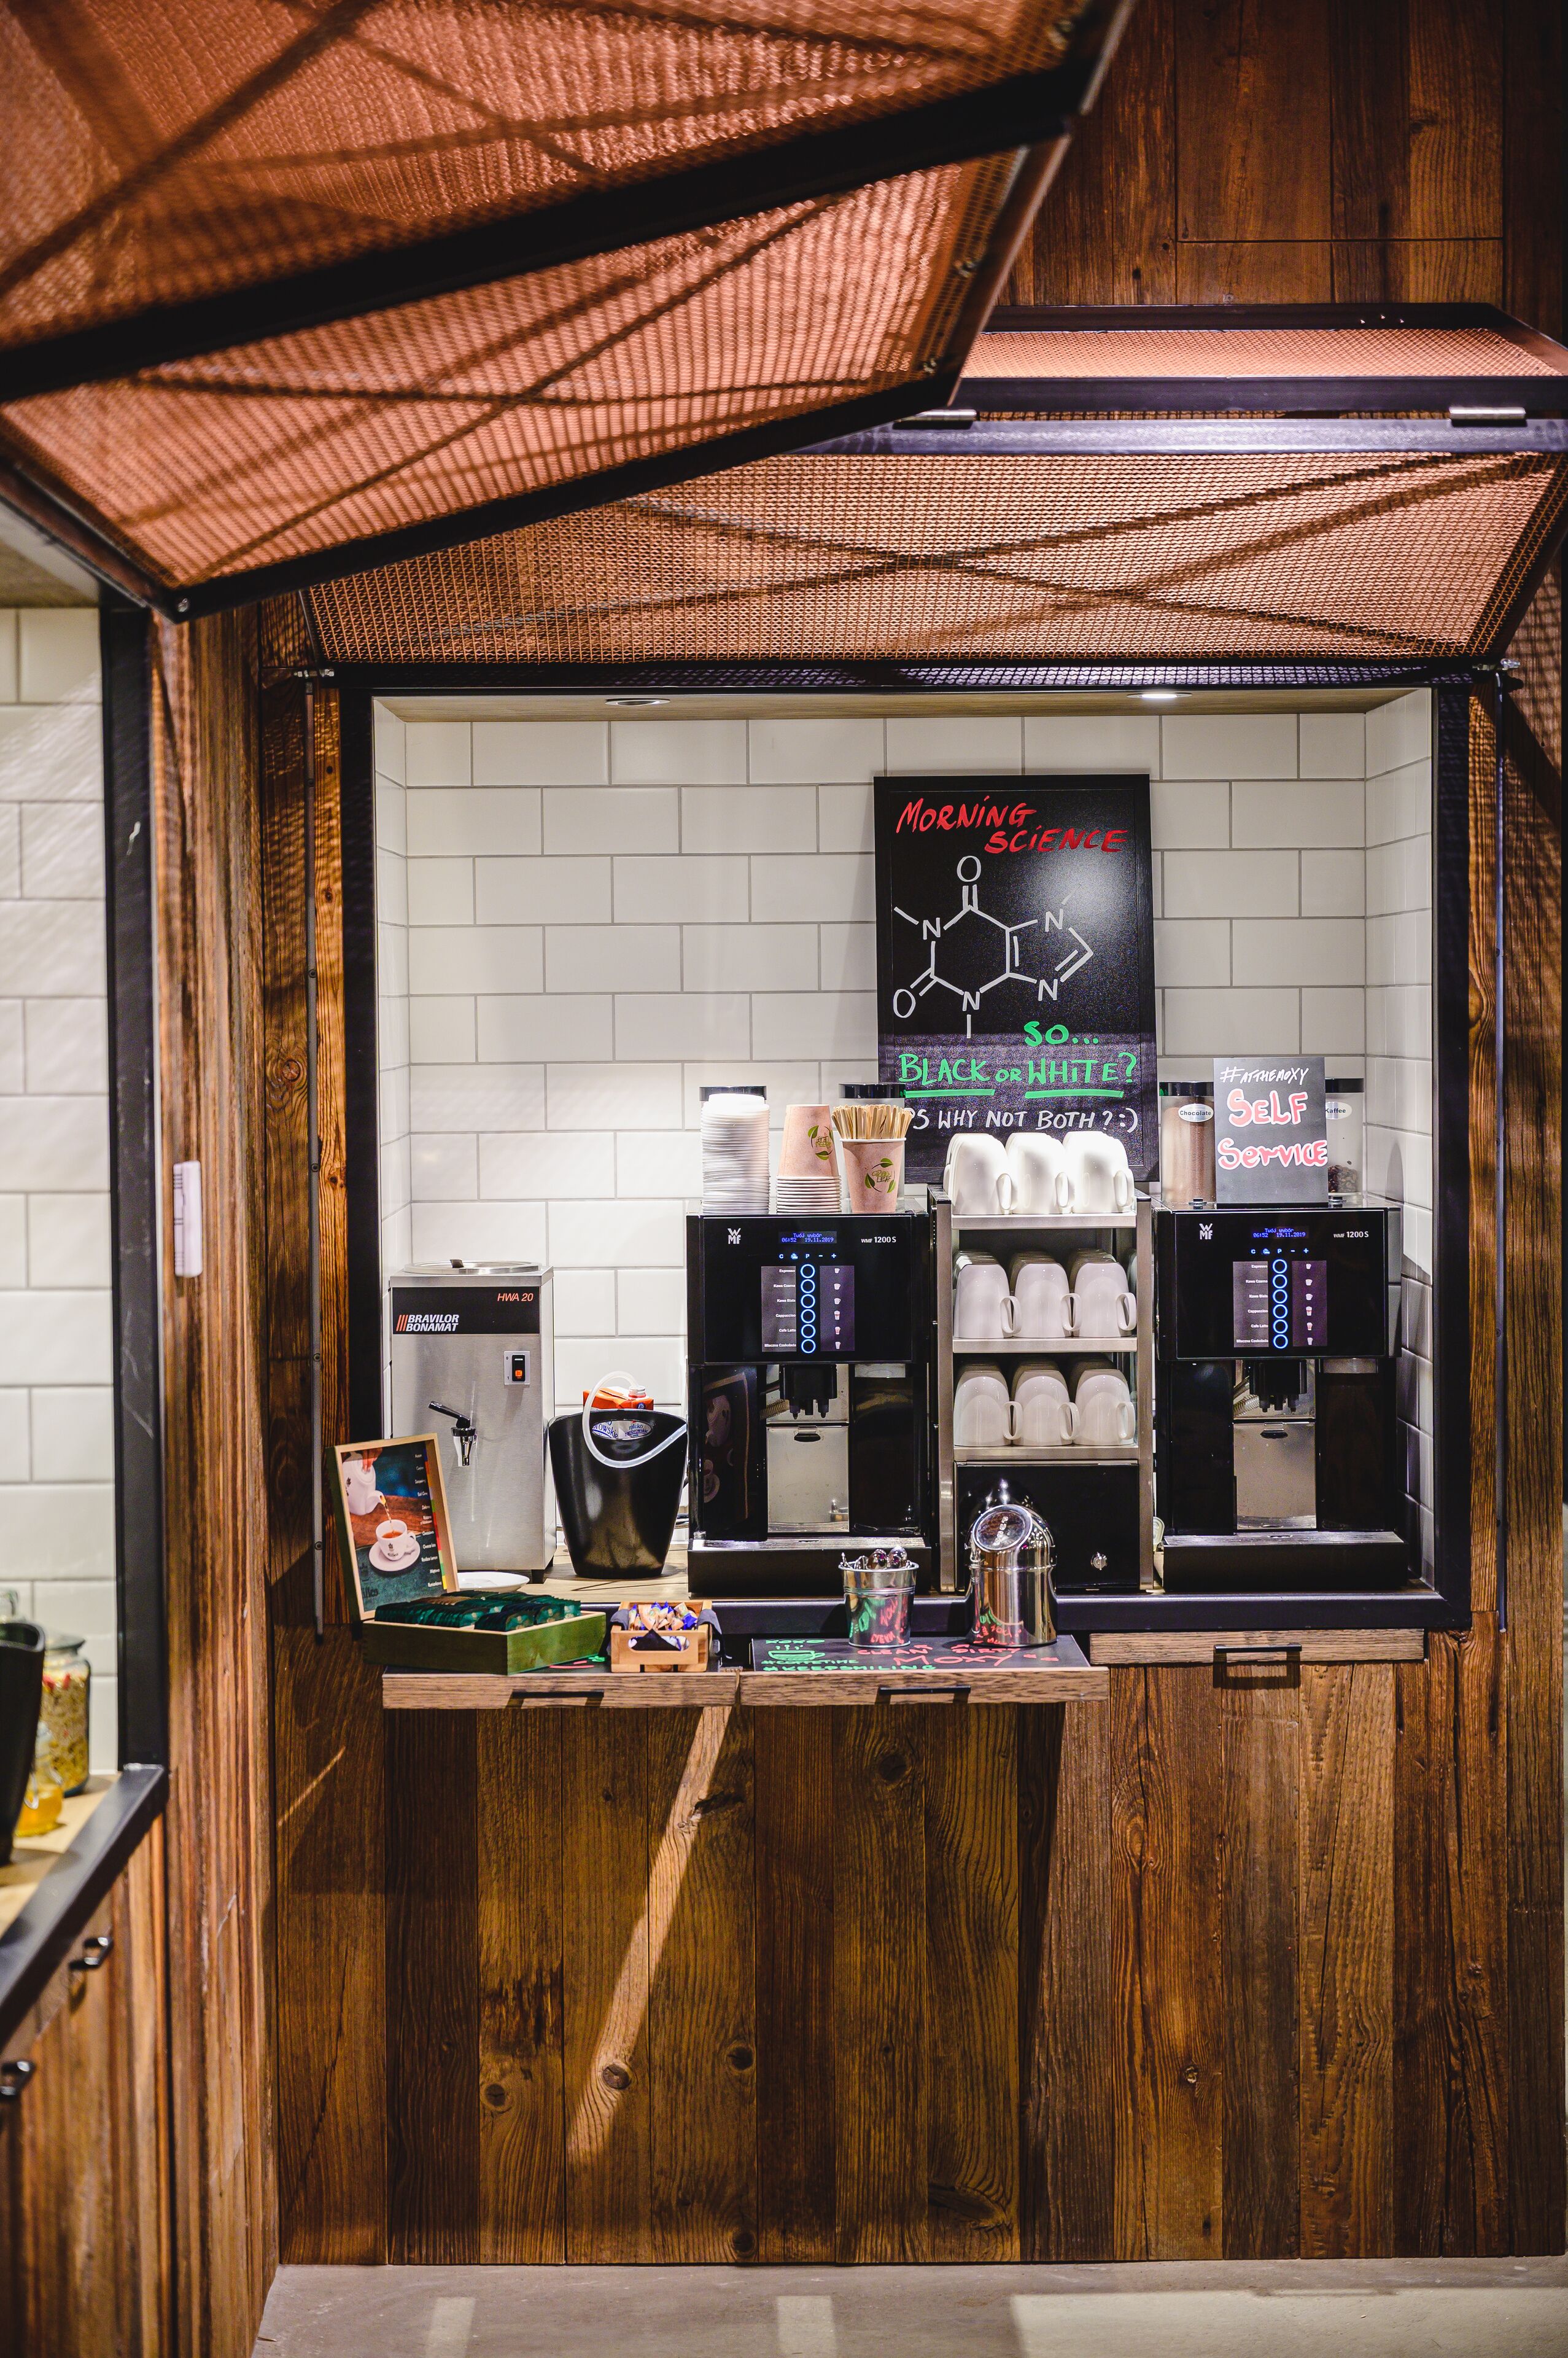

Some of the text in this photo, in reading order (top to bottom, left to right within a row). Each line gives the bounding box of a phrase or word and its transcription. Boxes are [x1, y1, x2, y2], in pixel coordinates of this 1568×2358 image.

[898, 1053, 990, 1086] BLACK
[1220, 1066, 1309, 1085] #ATTHEMOXY
[938, 1110, 978, 1129] WHY
[985, 1110, 1027, 1128] NOT
[408, 1314, 459, 1323] BRAVILOR
